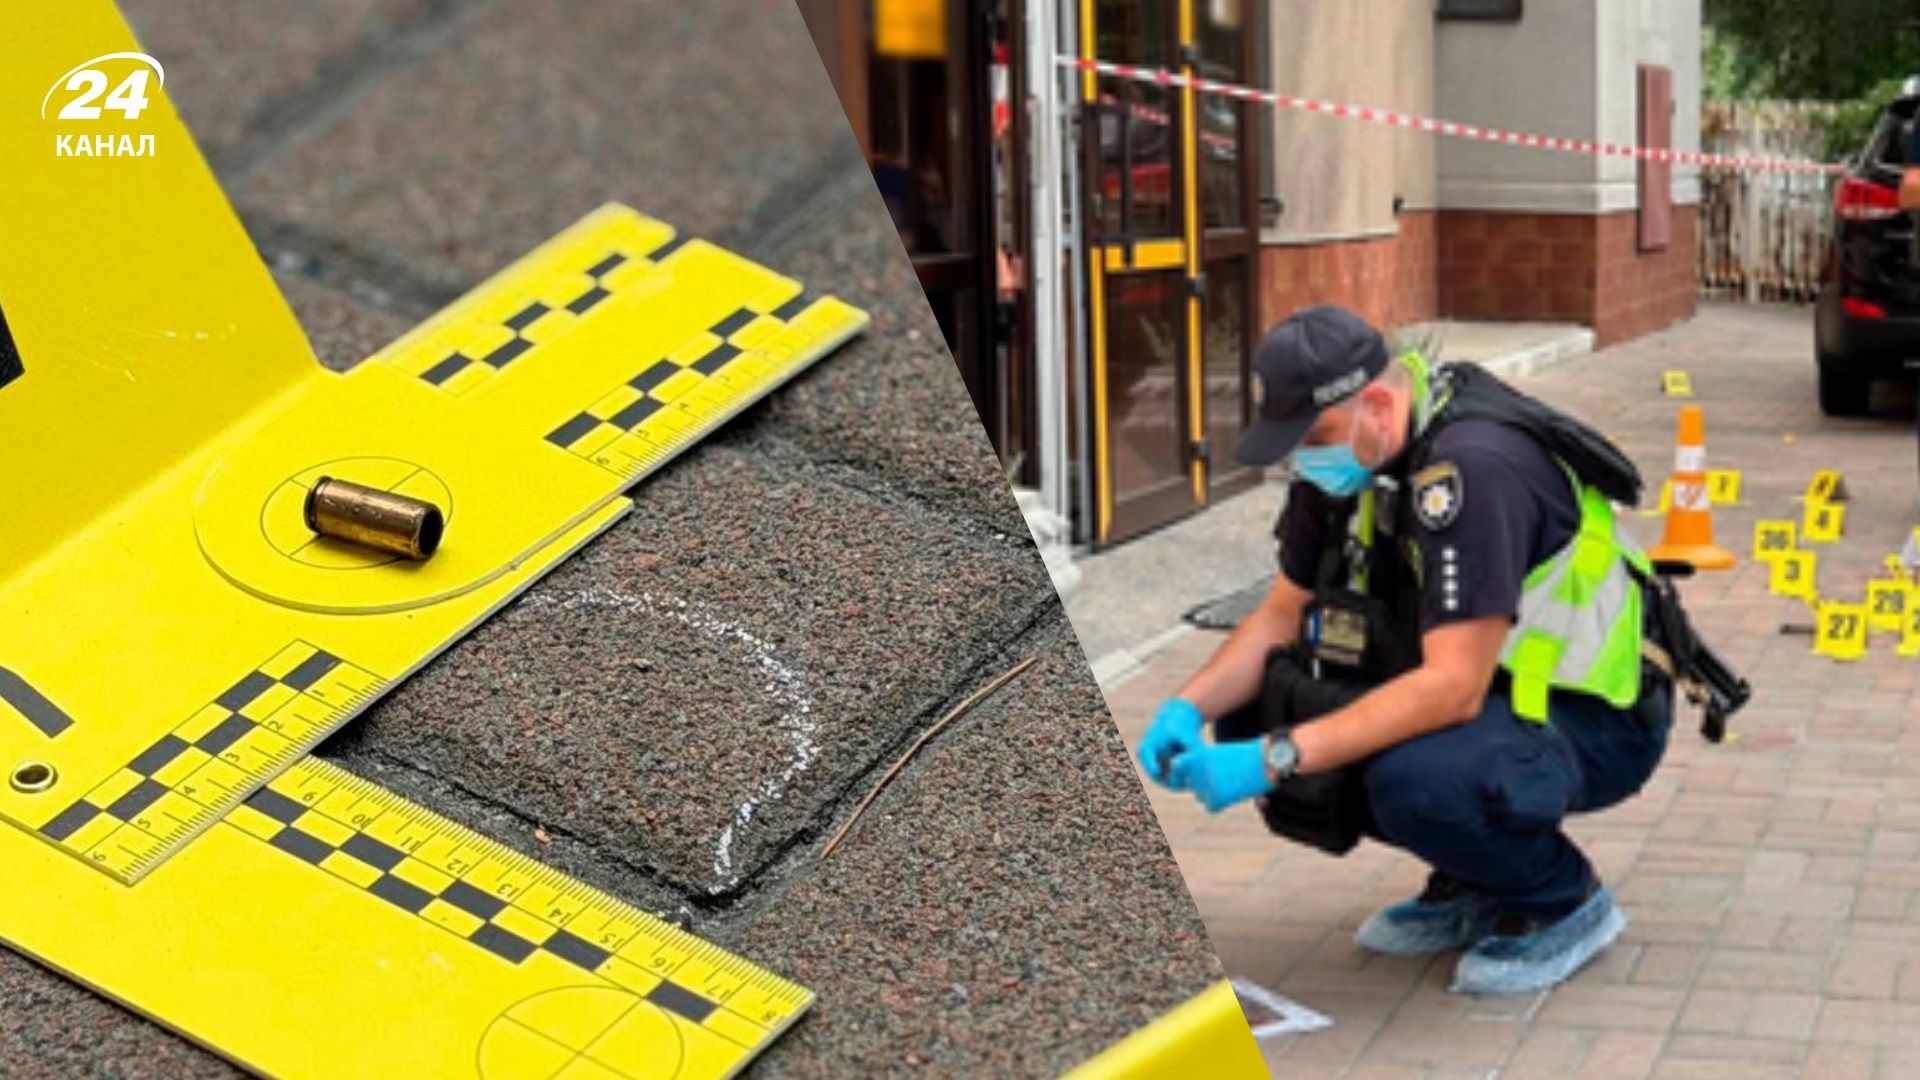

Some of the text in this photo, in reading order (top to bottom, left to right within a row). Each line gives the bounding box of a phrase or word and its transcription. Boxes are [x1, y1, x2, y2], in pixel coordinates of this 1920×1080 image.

[1827, 613, 1860, 640] 27
[137, 817, 152, 829] 5
[183, 785, 196, 796] 4
[225, 752, 241, 763] 3
[268, 720, 284, 731] 2
[352, 812, 373, 829] 10
[400, 835, 421, 851] 11
[447, 858, 470, 875] 12
[496, 883, 520, 898] 13
[548, 907, 572, 924] 14
[600, 932, 625, 949] 15
[650, 957, 676, 974] 16
[706, 985, 732, 1000] 17
